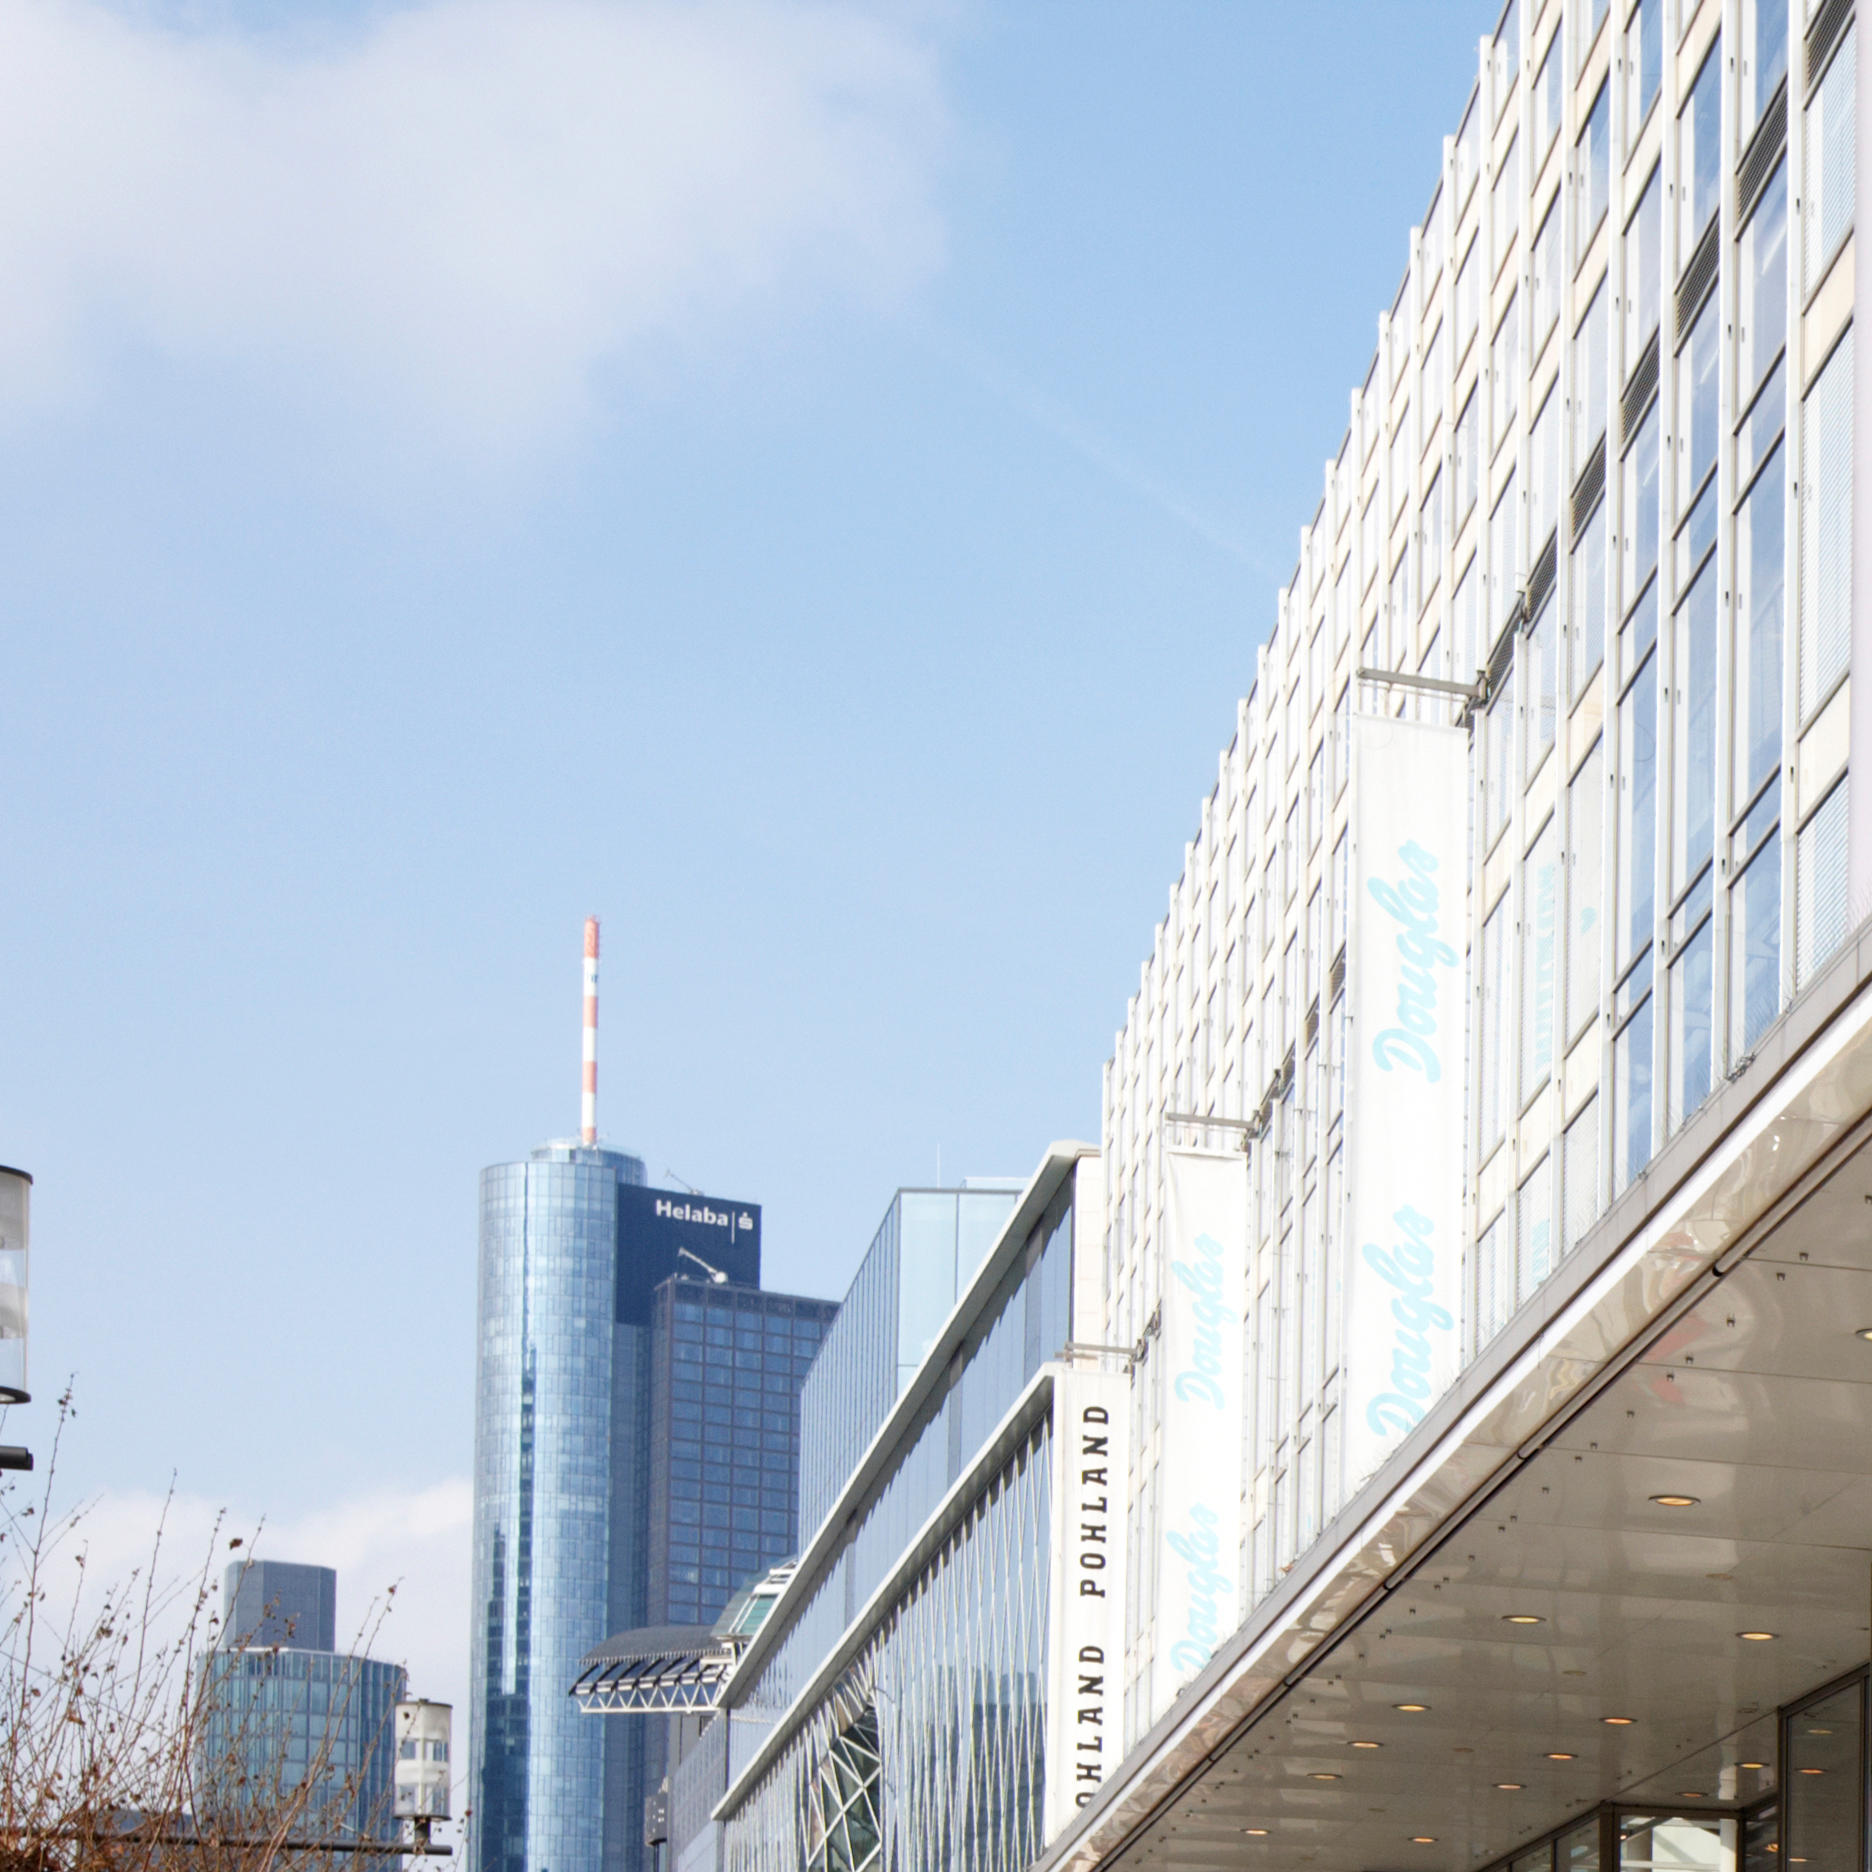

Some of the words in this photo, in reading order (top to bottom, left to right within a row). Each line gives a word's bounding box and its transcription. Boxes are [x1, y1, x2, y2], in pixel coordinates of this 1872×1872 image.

[1366, 838, 1460, 1083] Douglas
[656, 1199, 728, 1226] Helaba
[1172, 1232, 1238, 1410] Douglas
[1362, 1203, 1455, 1437] Douglas
[1079, 1404, 1109, 1598] POHLAND
[1165, 1501, 1233, 1679] Douglas
